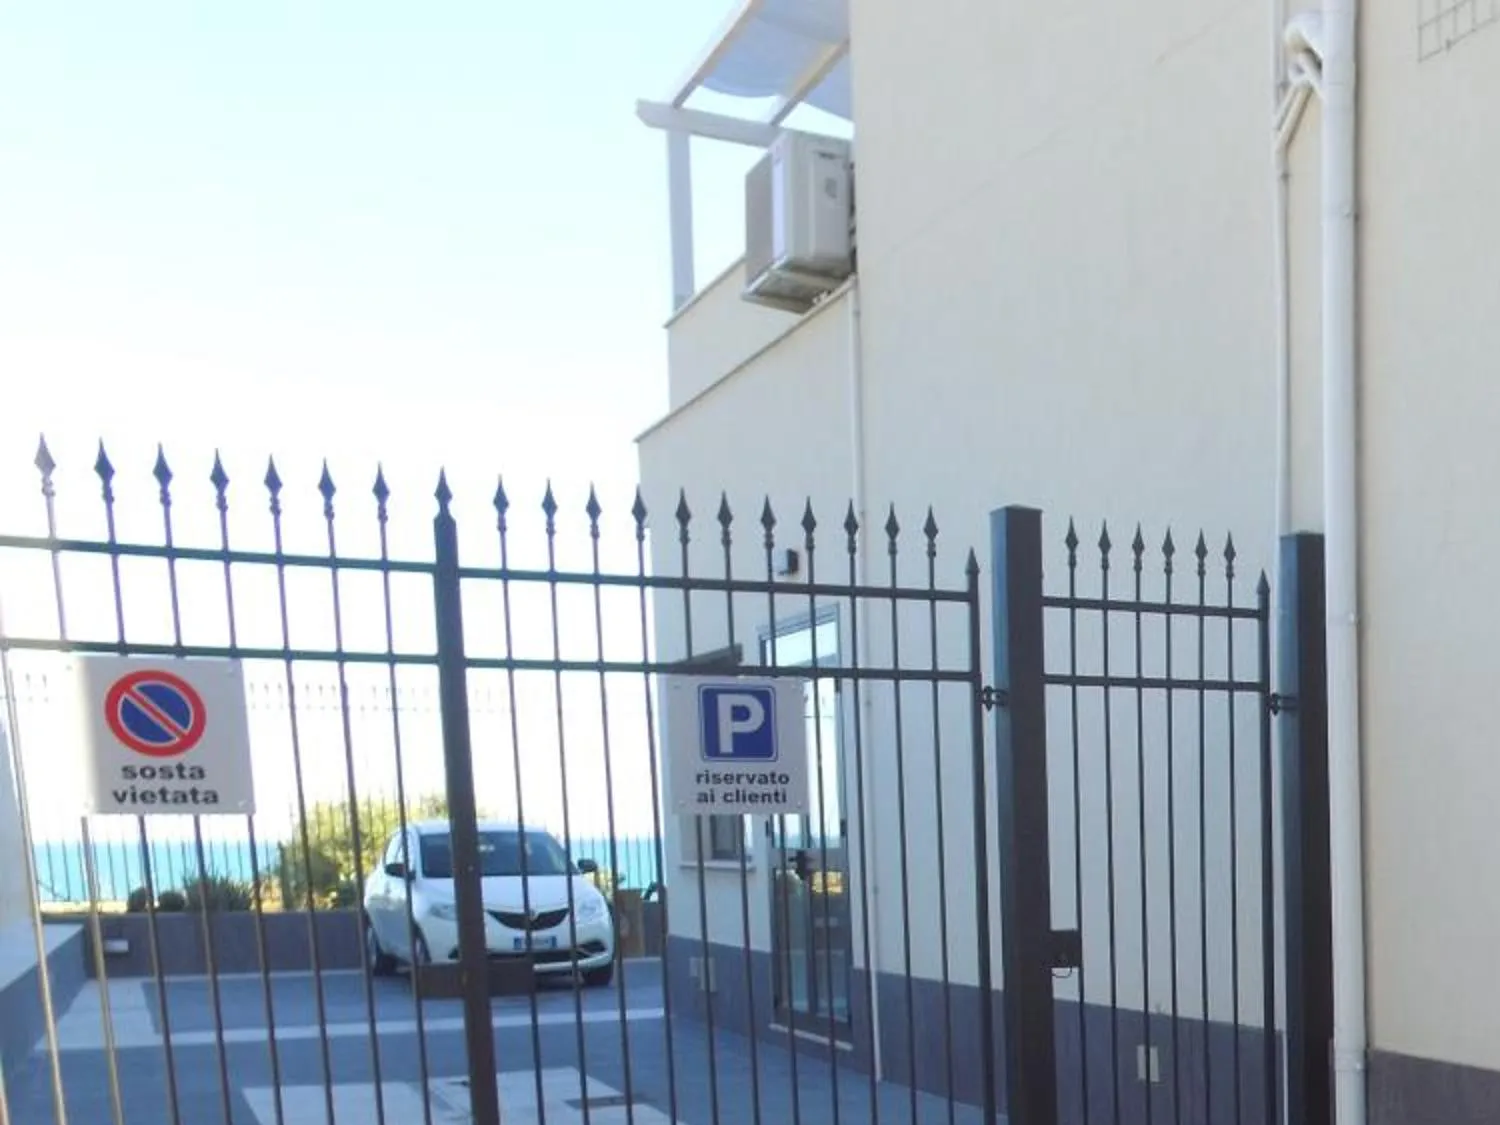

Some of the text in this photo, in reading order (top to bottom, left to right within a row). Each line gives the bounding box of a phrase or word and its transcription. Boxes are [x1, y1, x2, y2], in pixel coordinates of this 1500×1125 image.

[717, 693, 765, 754] P
[121, 762, 206, 780] sosta
[696, 769, 790, 785] riservato
[112, 785, 220, 804] vietata
[697, 787, 788, 804] ai clienti
